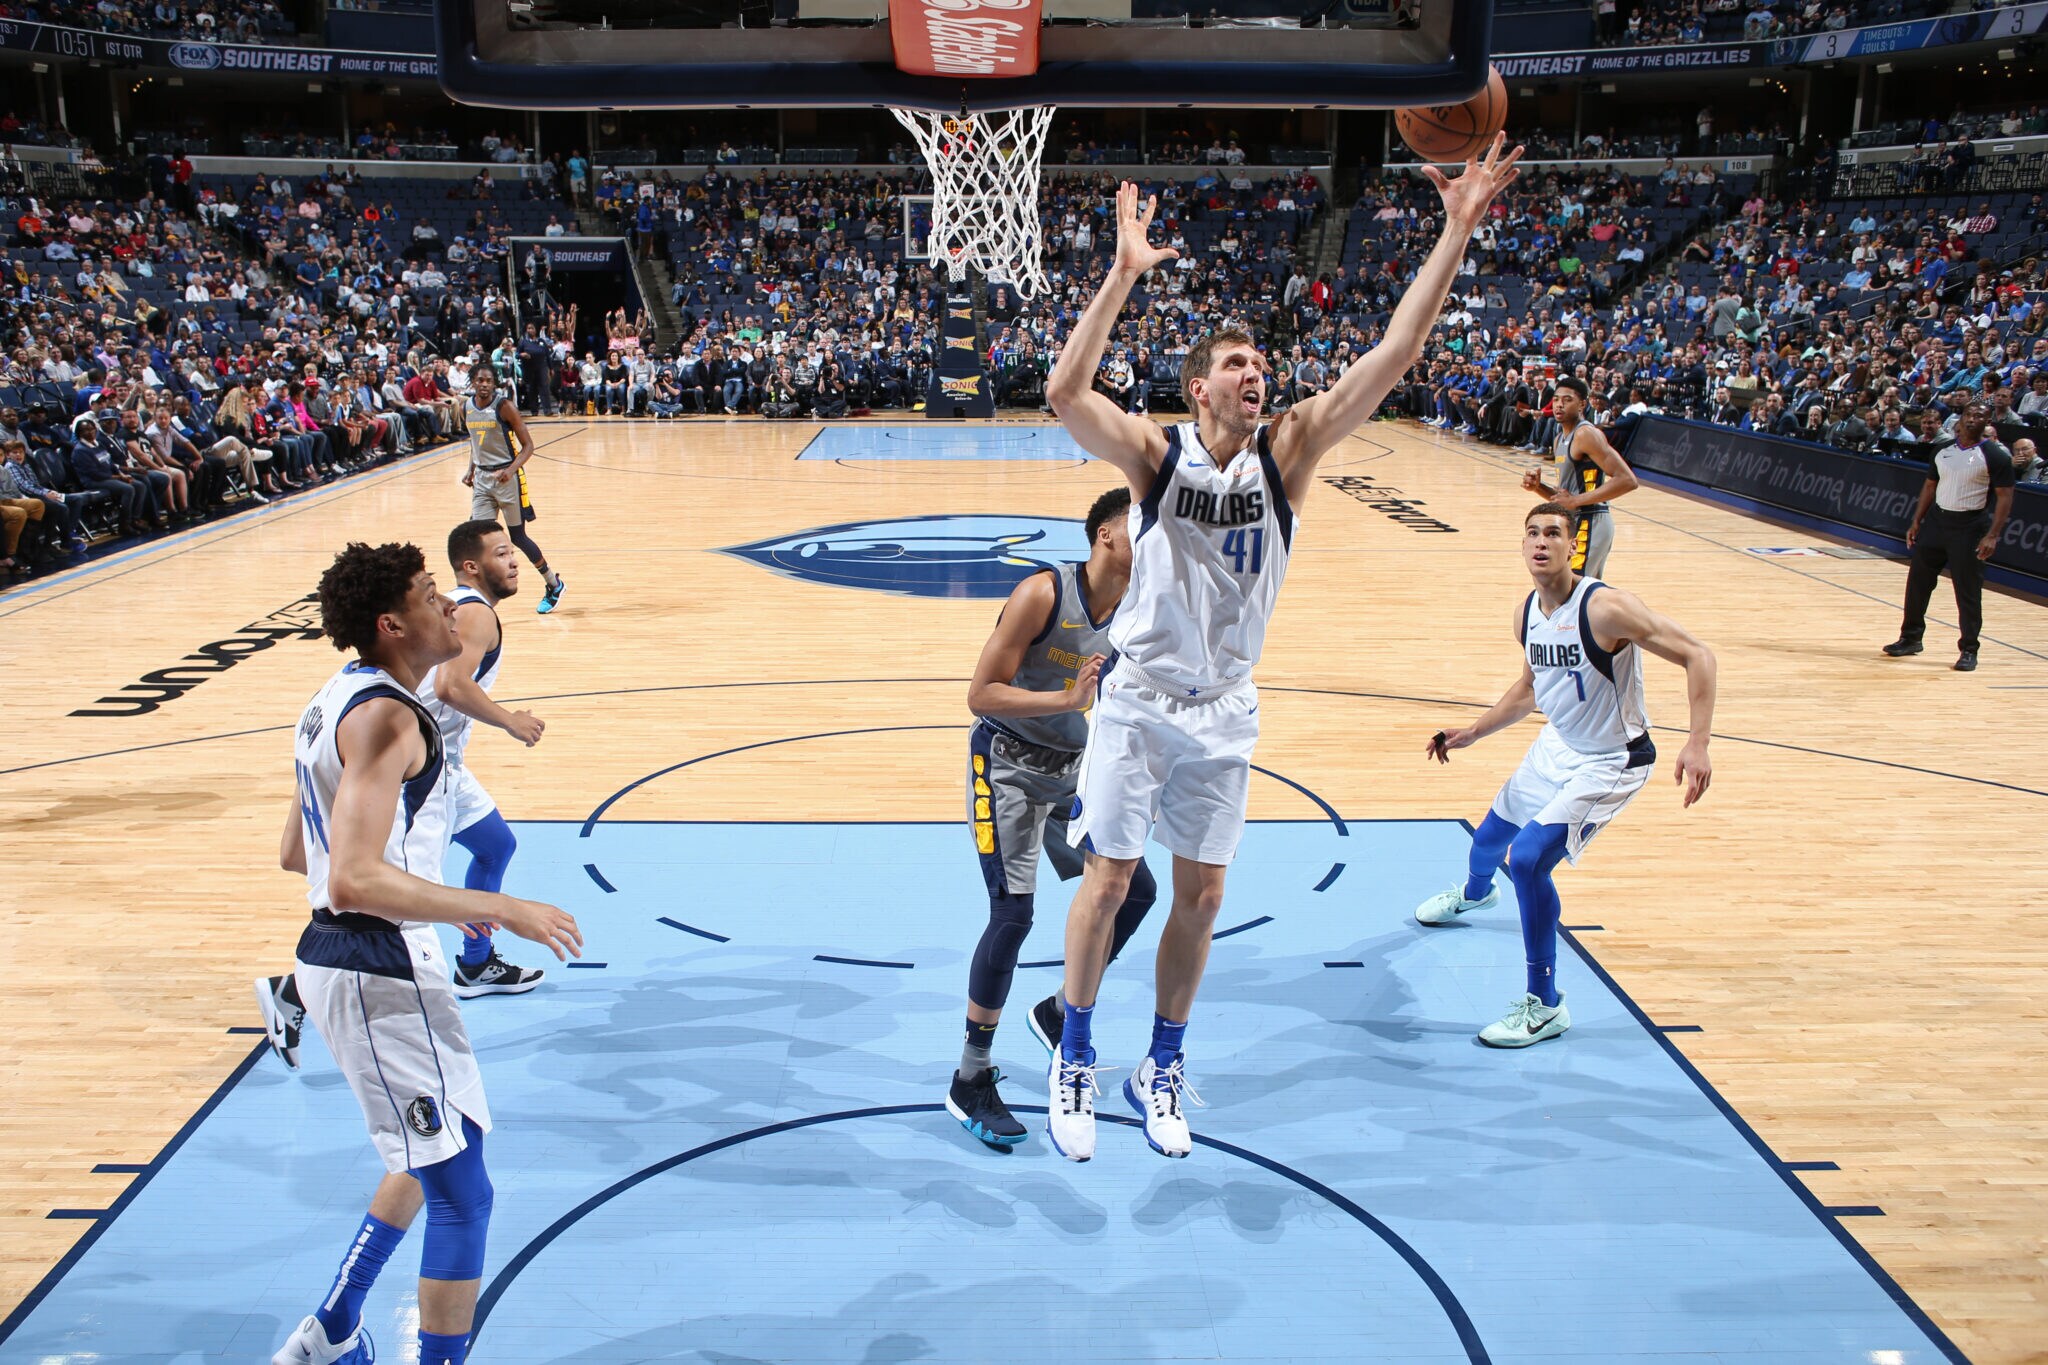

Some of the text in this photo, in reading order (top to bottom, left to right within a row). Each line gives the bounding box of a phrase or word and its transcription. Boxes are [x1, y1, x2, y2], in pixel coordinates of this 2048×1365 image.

[2011, 9, 2024, 34] 3
[54, 29, 95, 57] 10:51
[122, 43, 143, 58] QTR
[1863, 25, 1912, 42] TIMEOUTS: 7
[180, 43, 208, 60] FOX
[1826, 34, 1837, 58] 3
[1861, 41, 1889, 54] FOULS:
[223, 49, 333, 72] SOUTHEAST
[340, 58, 371, 71] HOME
[373, 60, 386, 71] OF
[388, 61, 407, 73] THE
[1592, 56, 1623, 70] HOME
[1625, 55, 1641, 68] OF
[1642, 54, 1662, 67] THE
[1664, 49, 1751, 67] GRIZZLIES
[1731, 160, 1748, 170] 108
[554, 251, 612, 262] SOUTHEAST
[947, 339, 974, 347] SONIC
[944, 382, 978, 390] SONIC
[476, 430, 487, 446] 7
[1701, 443, 1729, 472] The
[1730, 451, 1771, 481] MVP
[1769, 459, 1788, 488] in
[1789, 463, 1845, 502] home
[1175, 485, 1266, 527] DALLAS
[1222, 527, 1265, 574] 41
[1529, 643, 1582, 668] DALLAS
[1567, 669, 1586, 702] 7
